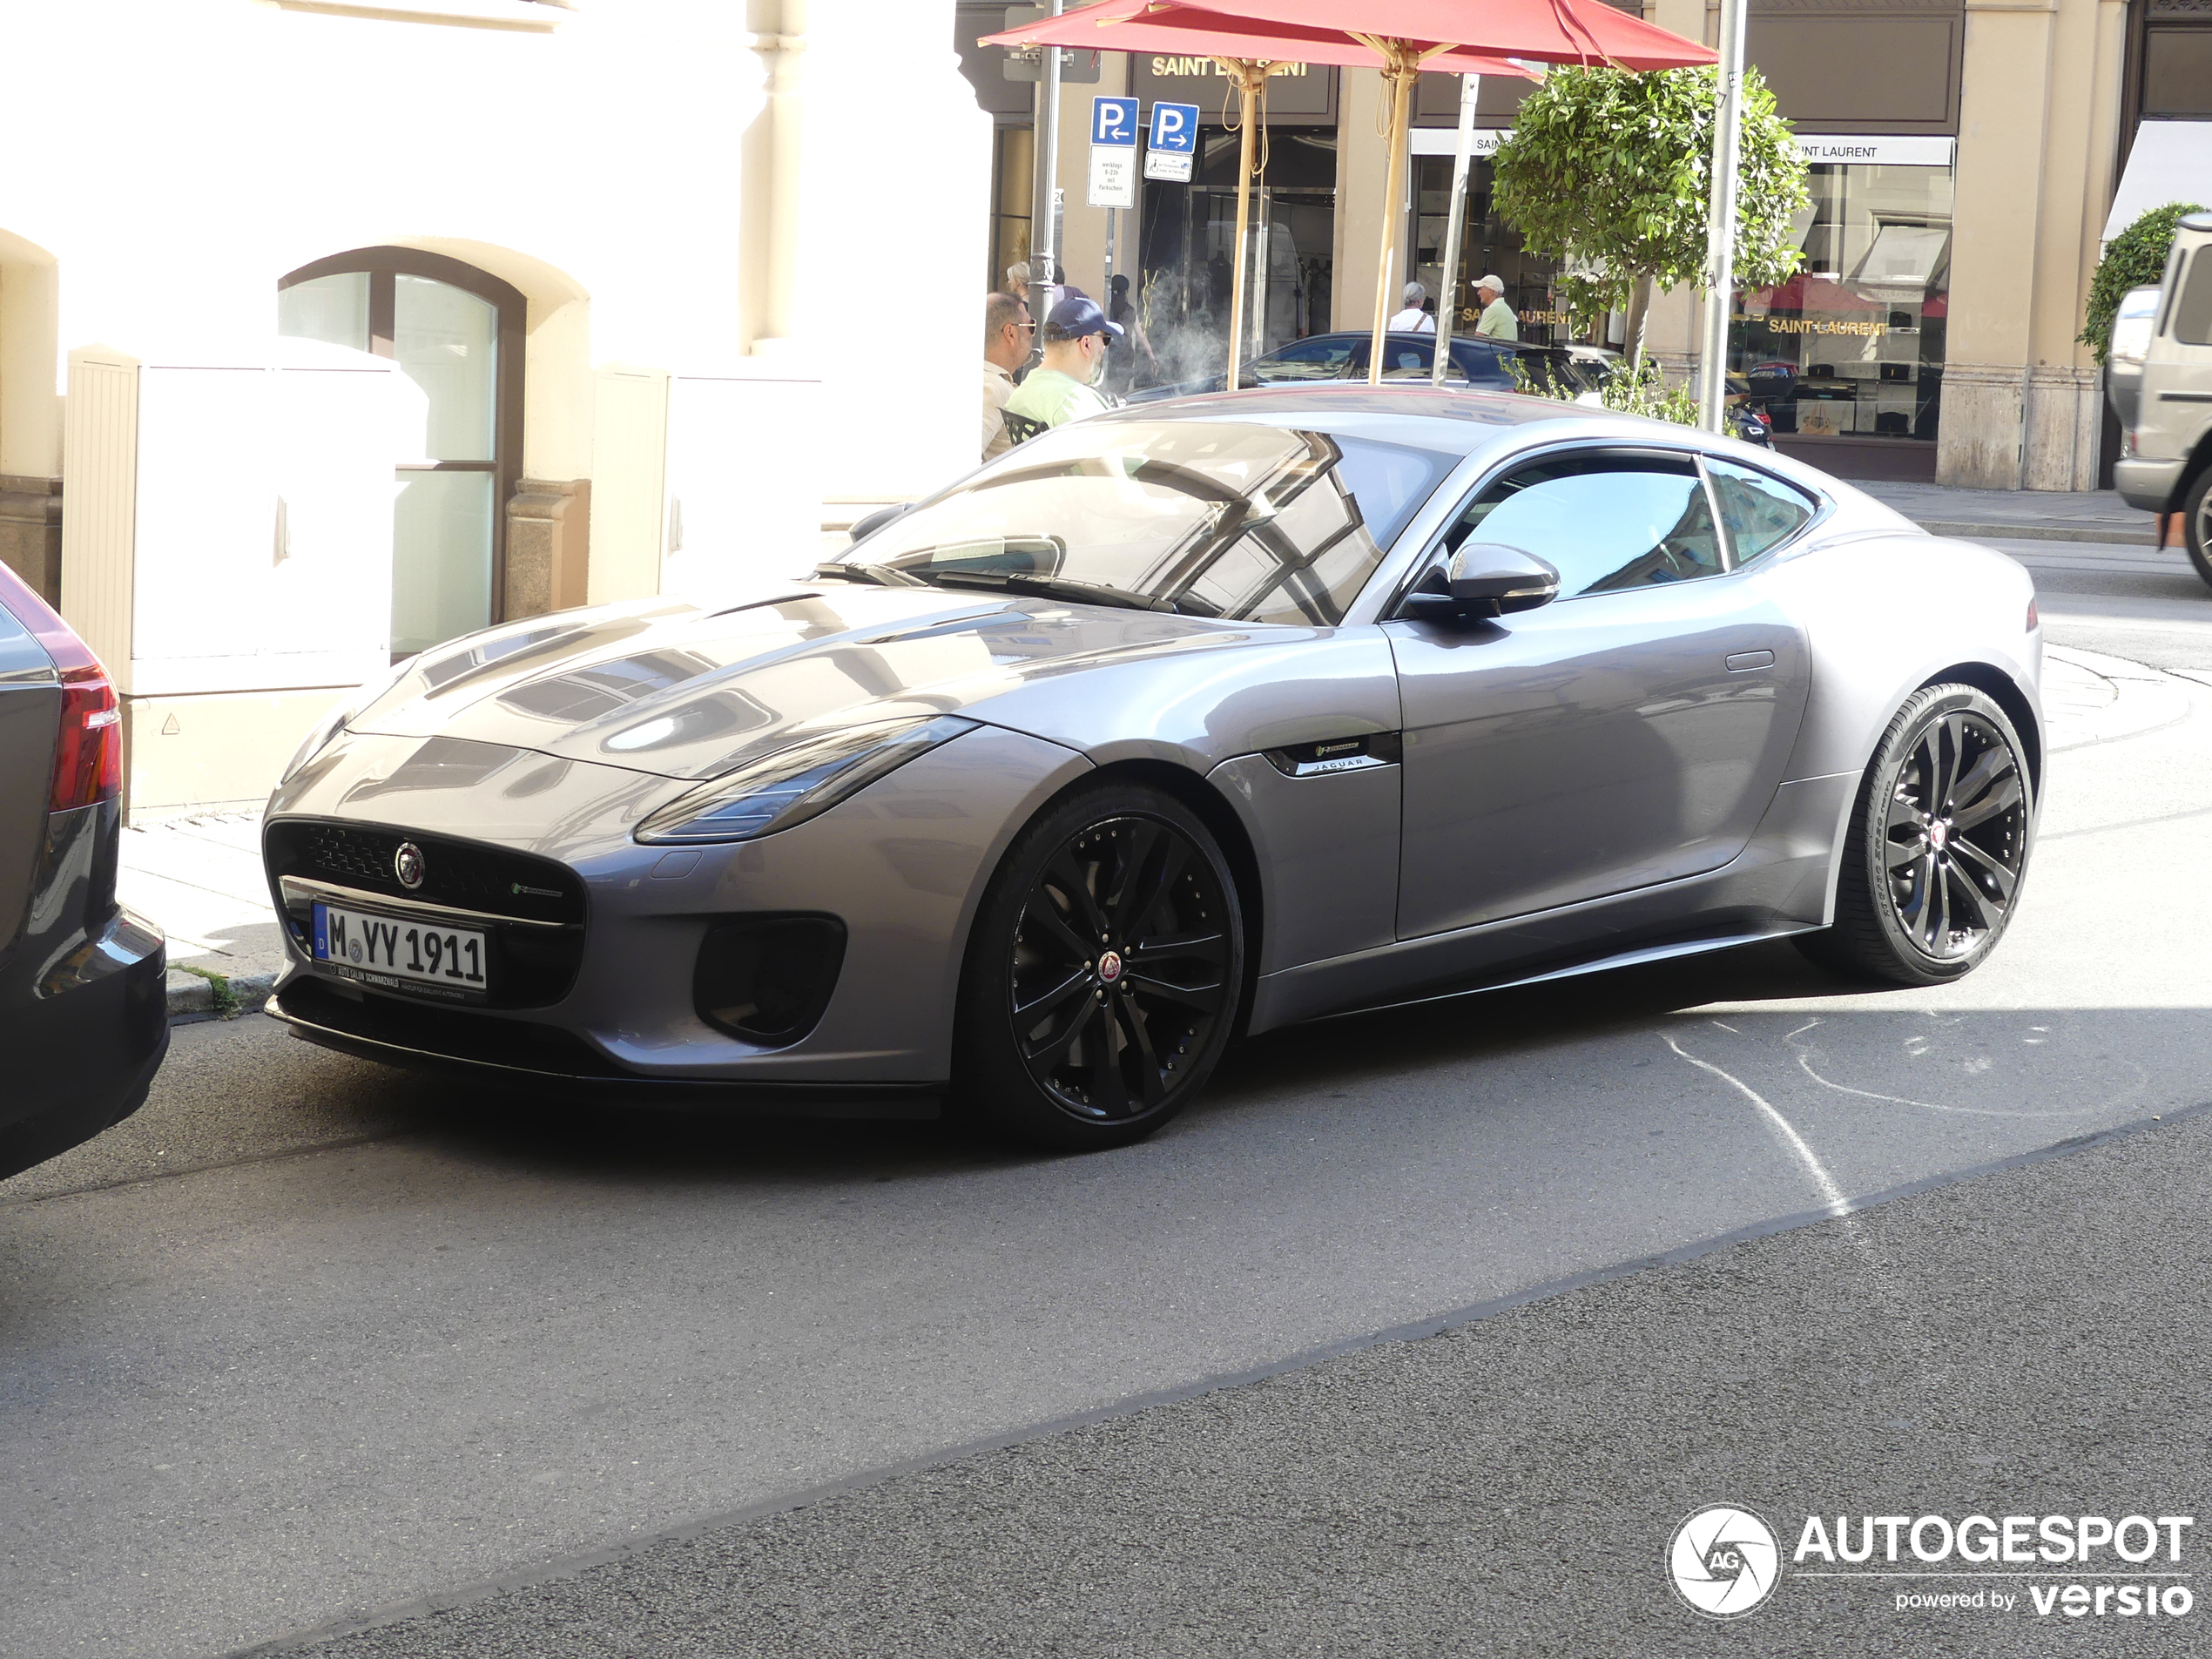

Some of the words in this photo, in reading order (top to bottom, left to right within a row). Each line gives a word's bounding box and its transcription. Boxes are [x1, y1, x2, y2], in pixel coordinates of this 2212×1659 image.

[1152, 57, 1211, 76] SAINT
[1099, 103, 1124, 139] P
[1157, 109, 1184, 145] P
[1823, 146, 1878, 157] LAURENT
[1769, 319, 1813, 334] SAINT
[1817, 320, 1889, 336] LAURENT
[1314, 759, 1363, 771] JAGUAR
[319, 937, 325, 950] D
[329, 913, 347, 957] M
[362, 920, 398, 967] YY
[405, 928, 484, 982] 1911
[338, 967, 349, 977] AUTO
[350, 969, 364, 981] SALON
